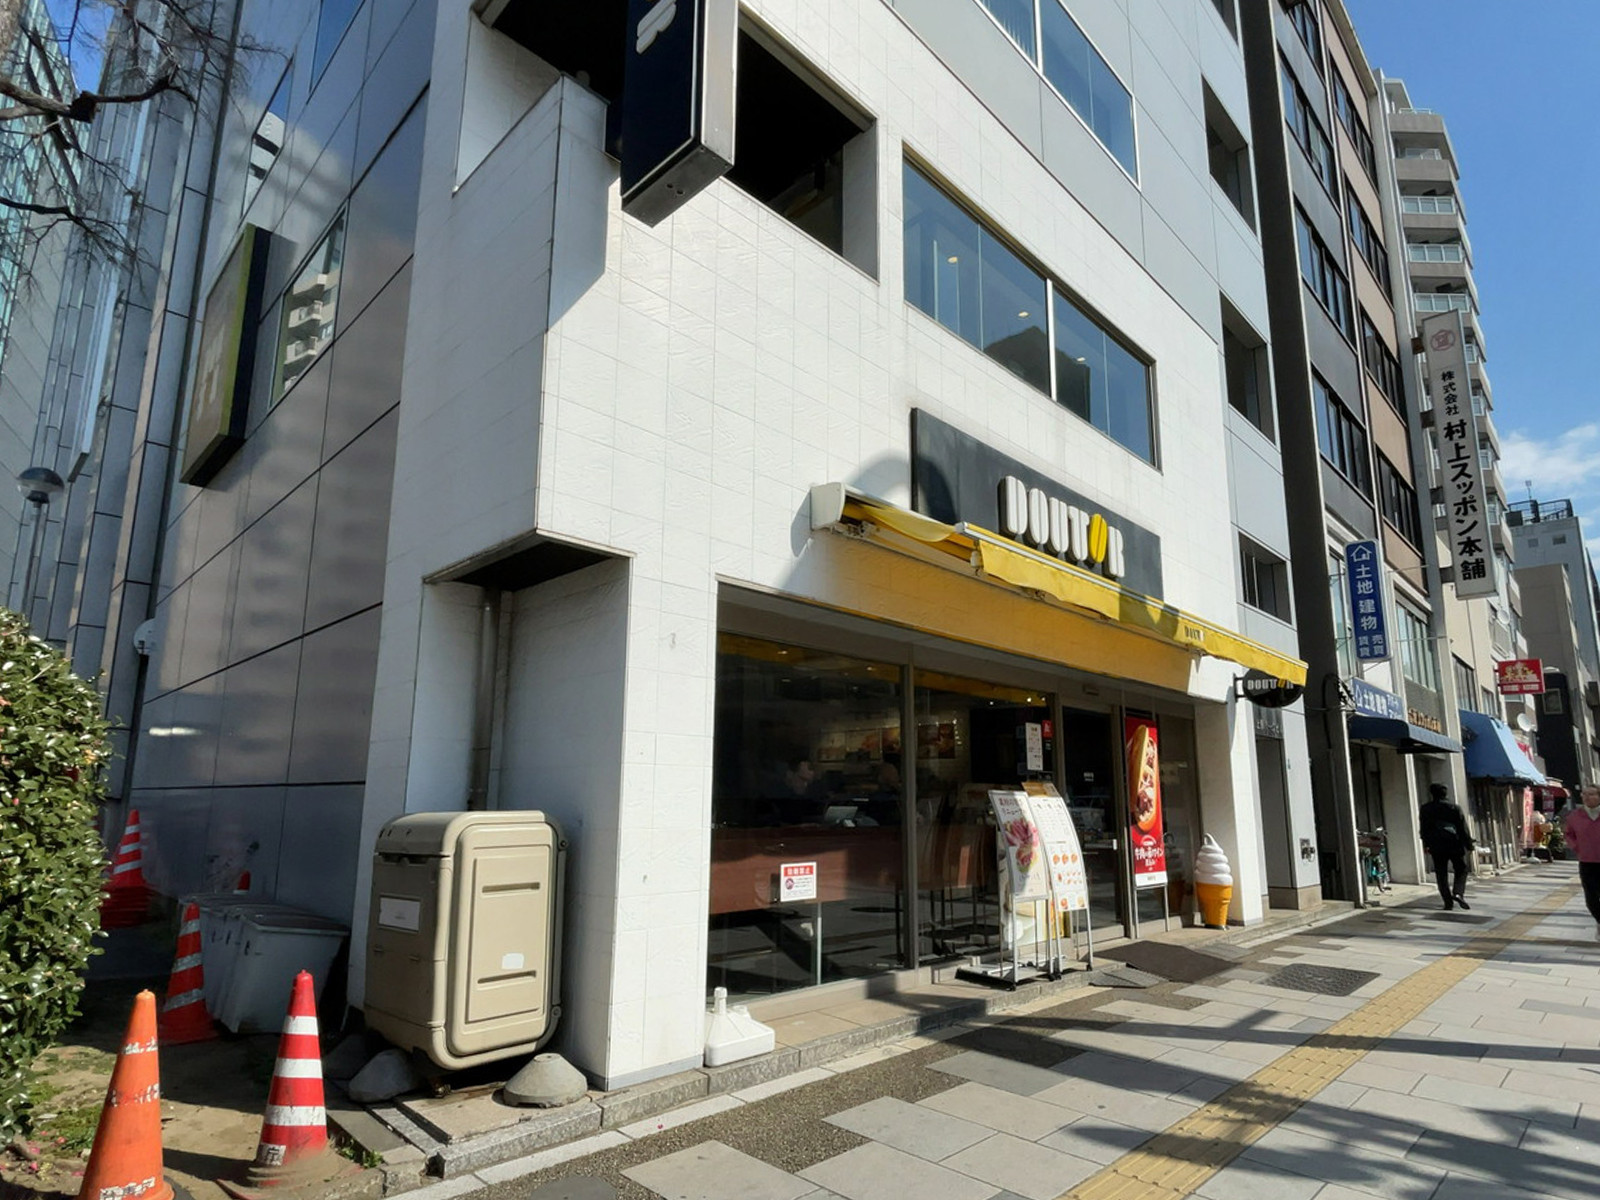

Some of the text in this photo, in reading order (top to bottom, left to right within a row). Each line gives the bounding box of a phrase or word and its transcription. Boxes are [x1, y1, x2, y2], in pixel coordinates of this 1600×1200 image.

[1441, 370, 1460, 416] 株式会社
[1005, 475, 1126, 578] DOUTOR
[1443, 419, 1487, 581] 村上スッポン本舗
[1355, 564, 1378, 631] 土地建物
